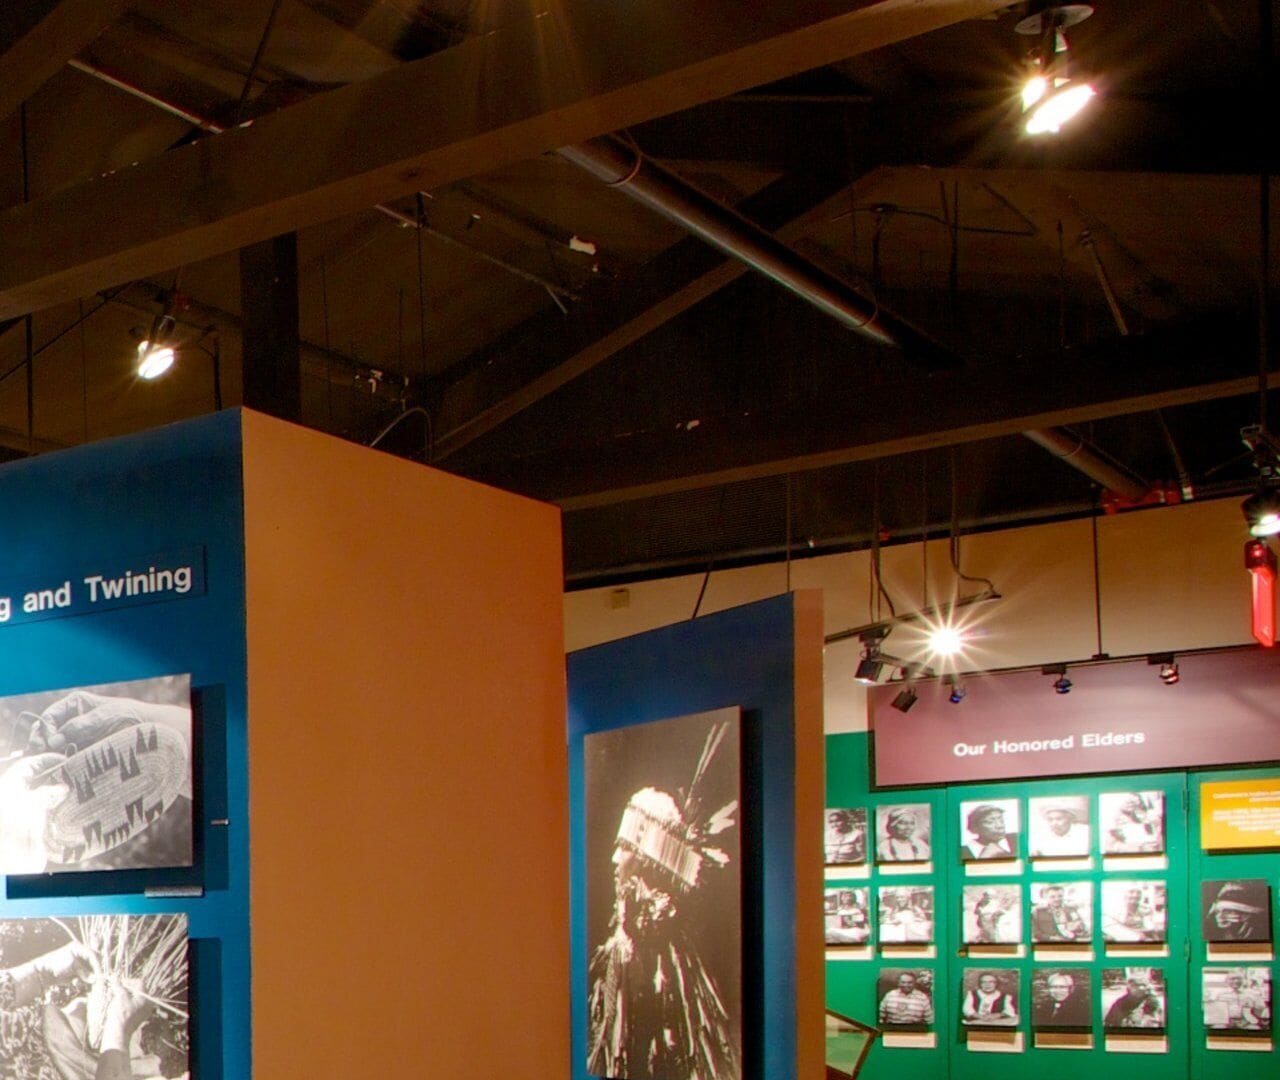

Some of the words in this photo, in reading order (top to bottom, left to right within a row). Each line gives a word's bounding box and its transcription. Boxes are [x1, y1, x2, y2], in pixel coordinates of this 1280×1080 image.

[23, 582, 71, 613] and
[84, 564, 192, 603] Twining
[953, 742, 987, 757] Our
[993, 735, 1074, 754] Honored
[1082, 731, 1145, 748] Elders
